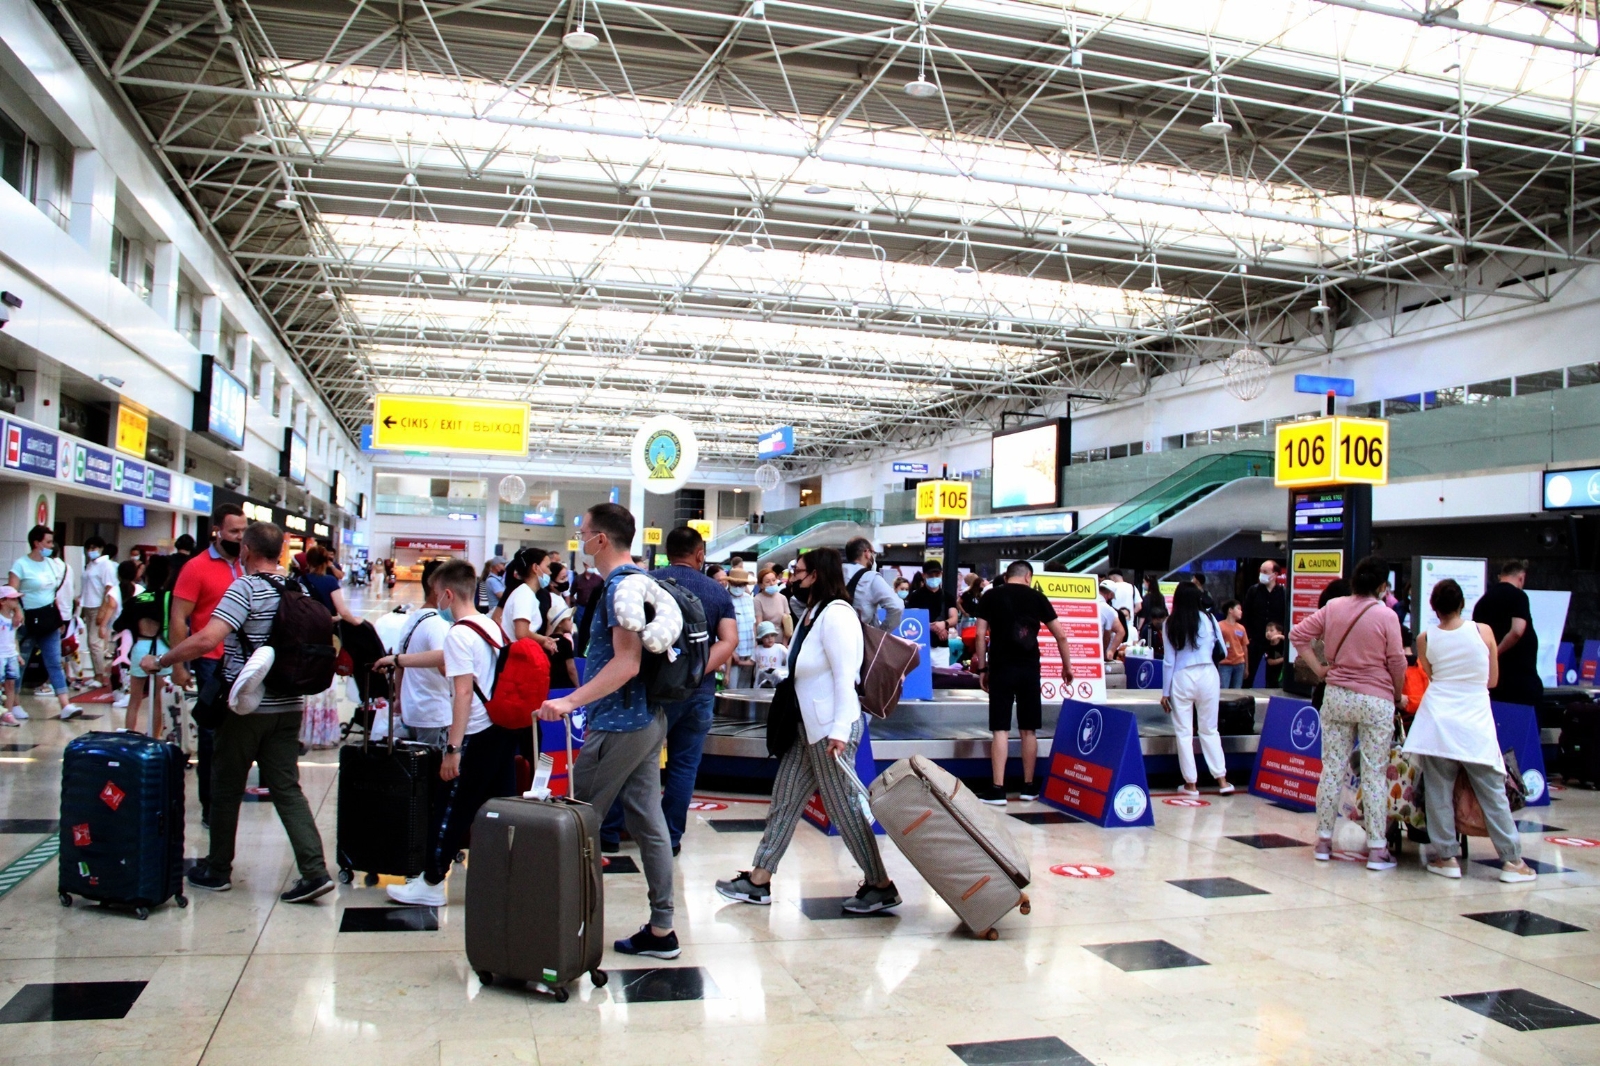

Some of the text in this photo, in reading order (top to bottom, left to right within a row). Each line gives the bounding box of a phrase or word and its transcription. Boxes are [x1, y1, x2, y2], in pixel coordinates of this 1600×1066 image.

[401, 417, 429, 431] ÇIKIŞ
[440, 419, 462, 430] EXIT
[473, 421, 521, 434] ВЫХОД
[1284, 434, 1325, 468] 106
[1340, 434, 1383, 468] 106
[920, 490, 934, 509] 105
[940, 490, 967, 509] 105
[648, 532, 660, 540] 103
[1308, 559, 1336, 568] CAUTION
[1048, 582, 1090, 593] CAUTION
[1266, 760, 1280, 770] SOSYAL
[1290, 756, 1305, 765] LÜTFEN
[1074, 763, 1087, 772] LÜTFEN
[1284, 779, 1300, 788] PLEASE
[1068, 787, 1080, 796] PLEASE
[1260, 782, 1316, 802] KEEP YOUR SOCIAL DISTAN
[1070, 796, 1080, 806] MASK
